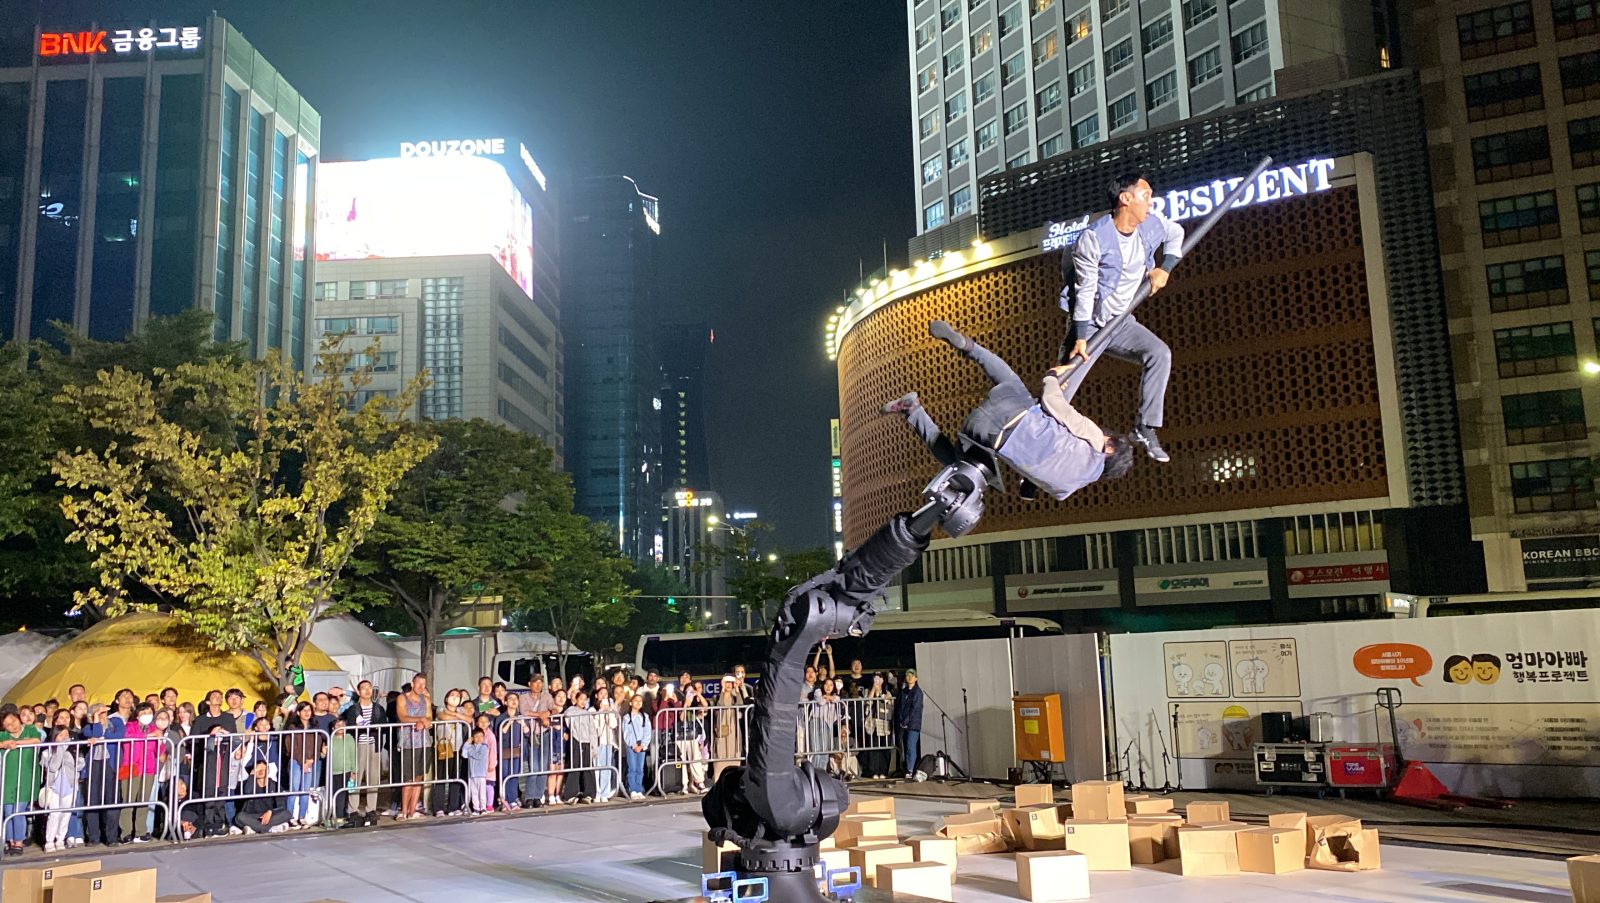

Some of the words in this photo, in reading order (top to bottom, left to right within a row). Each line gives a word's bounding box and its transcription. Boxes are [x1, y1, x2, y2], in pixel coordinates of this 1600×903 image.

[40, 31, 107, 56] BNK
[112, 27, 201, 53] 금융그룹
[400, 139, 505, 158] DOUZONE
[1149, 158, 1335, 222] RESIDENT
[1049, 215, 1089, 238] Hotel
[1523, 550, 1571, 560] KOREAN
[1505, 650, 1588, 670] 엄마아빠
[1512, 670, 1590, 684] 행복프로젝트
[703, 682, 720, 694] ICE
